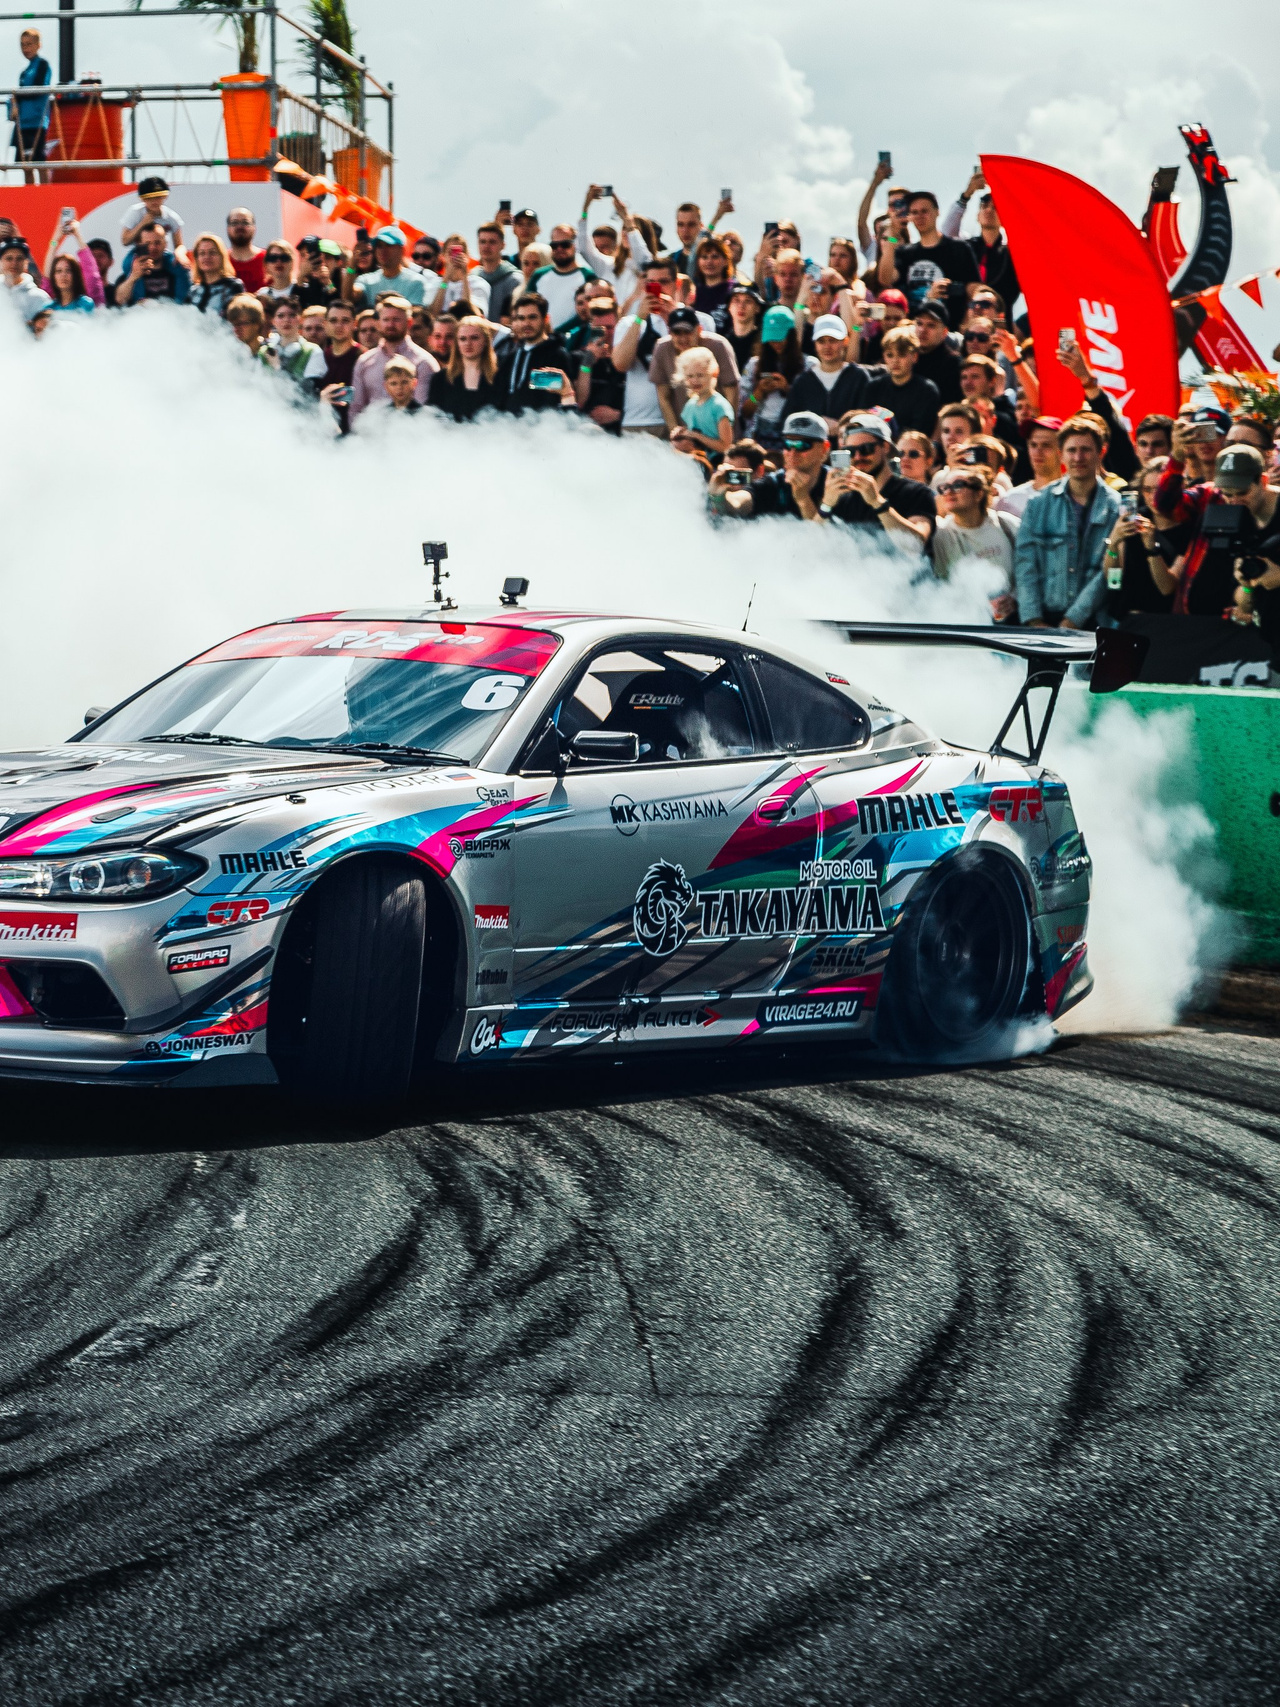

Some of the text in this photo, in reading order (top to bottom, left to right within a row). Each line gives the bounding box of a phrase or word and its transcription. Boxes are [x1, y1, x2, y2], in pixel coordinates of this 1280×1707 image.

[461, 675, 525, 710] 6
[628, 693, 686, 706] GReddy
[328, 774, 443, 795] TIVODAR
[611, 799, 729, 824] MK KASHIYAMA
[857, 790, 965, 835] MAHLE
[989, 787, 1042, 822] CTR
[465, 839, 511, 851] ВИРАЖ
[219, 850, 309, 875] MAHLE
[799, 859, 877, 881] MOTOR OIL
[207, 898, 270, 923] CTR
[697, 885, 887, 938] TAKAYAMA
[171, 949, 228, 965] FORWARD
[172, 958, 225, 970] RACING
[811, 946, 867, 967] SKILL
[643, 1009, 691, 1028] AUTO
[765, 1001, 858, 1022] VIRAGE24.RU
[162, 1033, 256, 1053] JONNESWAY
